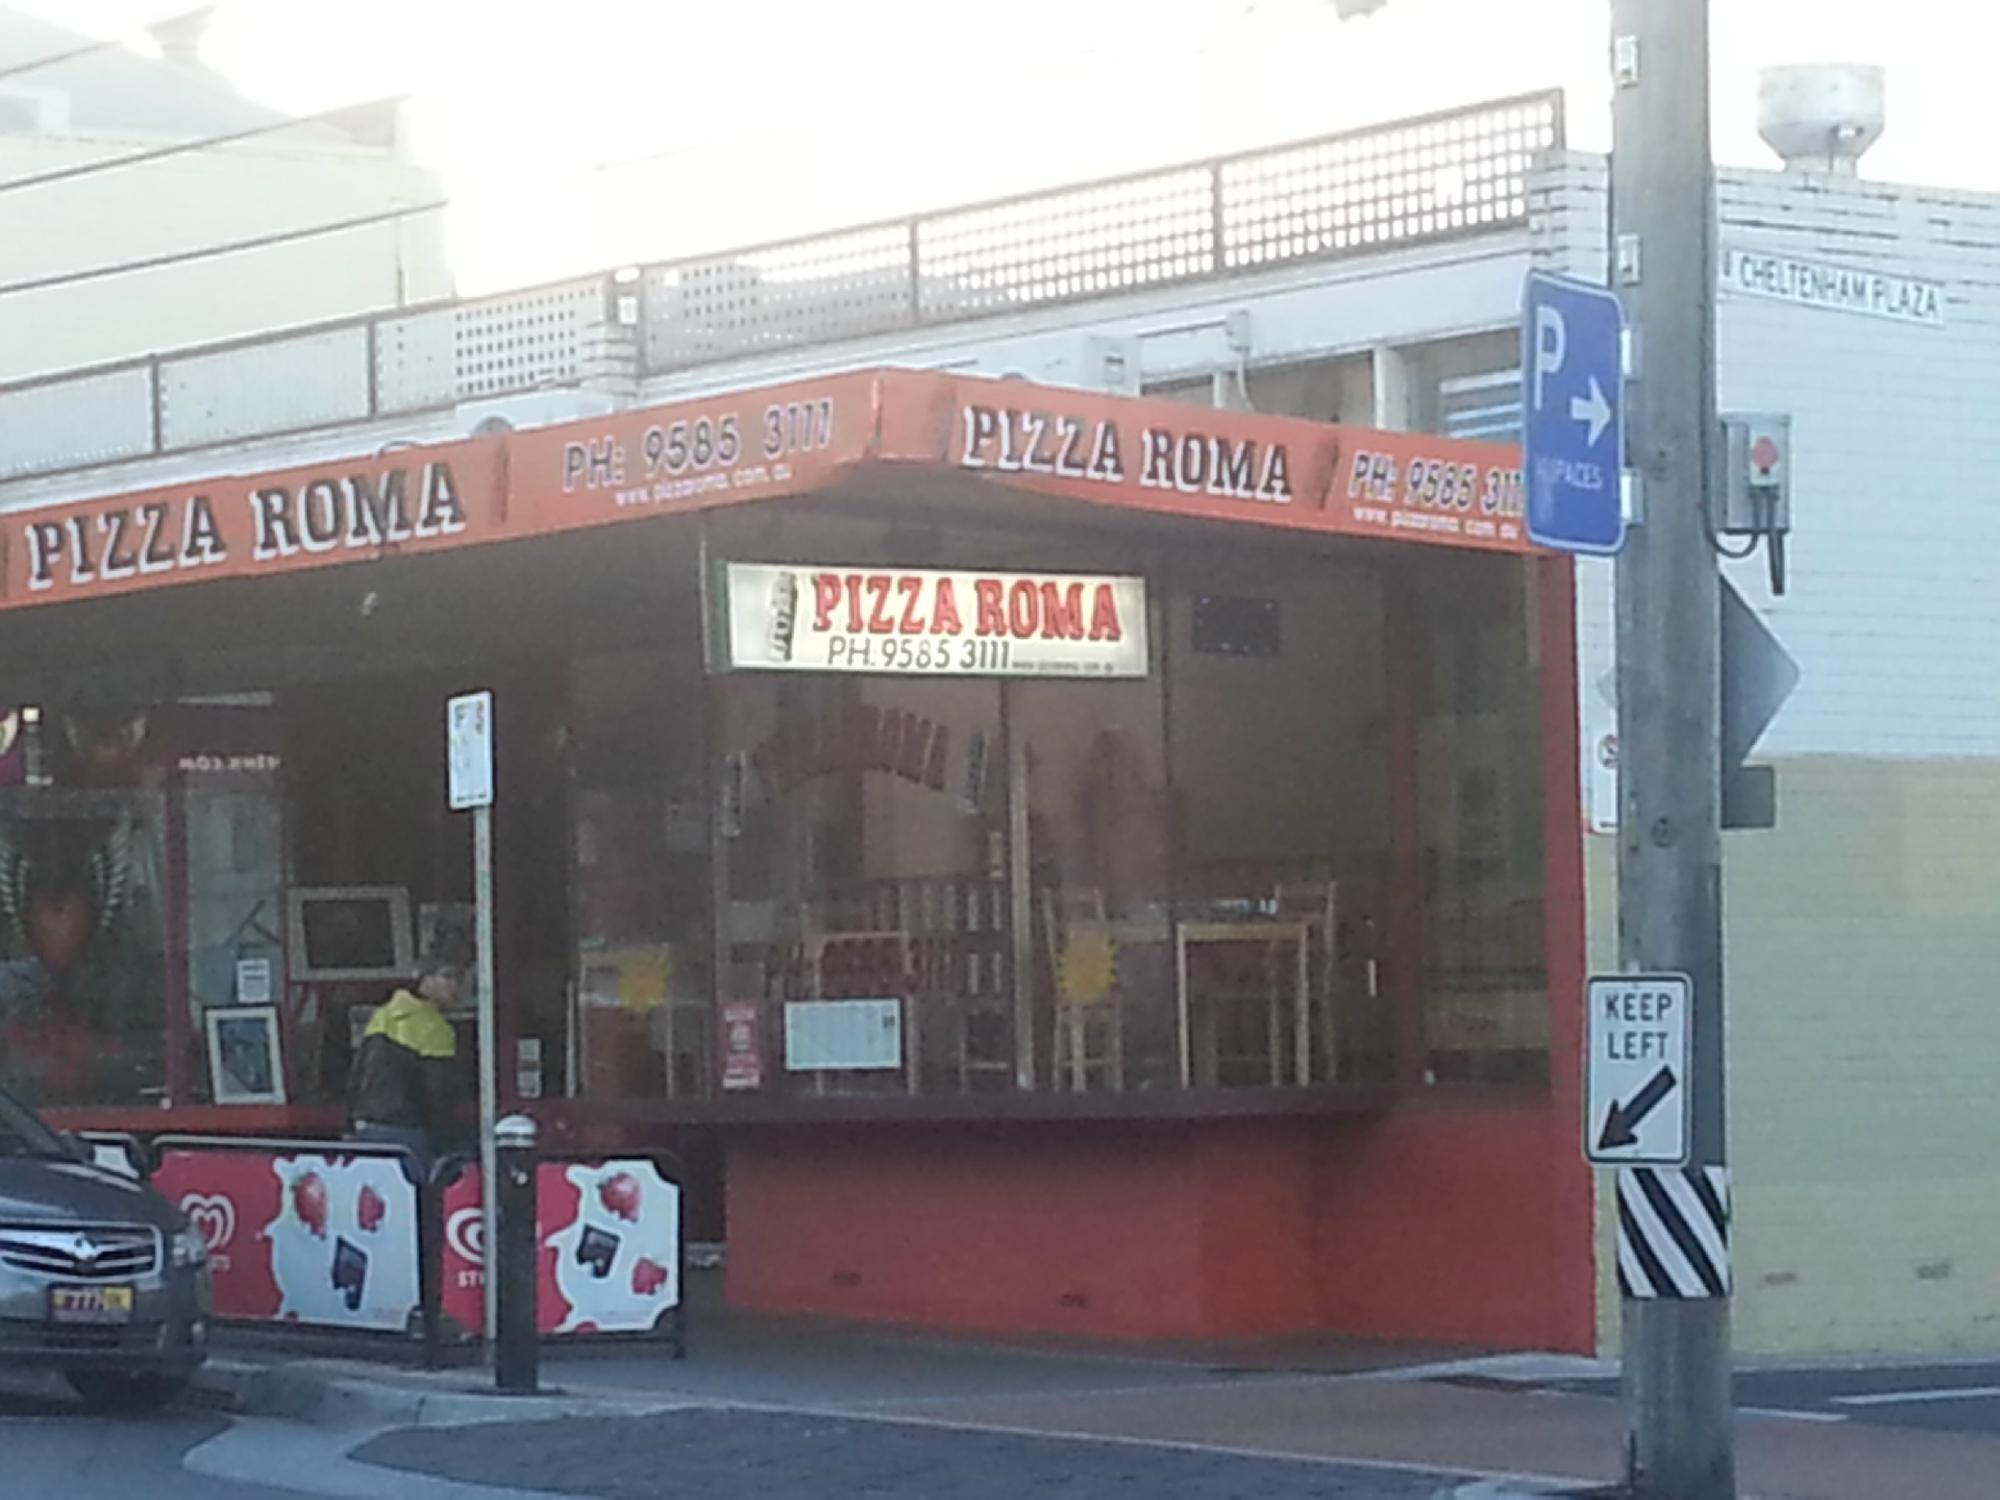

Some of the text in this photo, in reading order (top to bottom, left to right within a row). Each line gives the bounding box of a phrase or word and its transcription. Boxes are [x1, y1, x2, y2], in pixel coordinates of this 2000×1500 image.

[1740, 255, 1867, 300] CHELTENHAM
[1873, 279, 1942, 317] PLAZA
[1534, 303, 1567, 411] P
[562, 397, 834, 493] PH: 9585 3111
[962, 405, 1292, 503] PIZZA ROMA
[1347, 449, 1396, 503] PH:
[1403, 457, 1477, 512] 9585
[25, 462, 466, 590] PIZZA ROMA
[811, 574, 1122, 642] PIZZA ROMA
[880, 637, 951, 669] 9585
[959, 638, 1010, 670] 3111
[1604, 993, 1672, 1020] KEEP
[1607, 1031, 1668, 1060] LEFT
